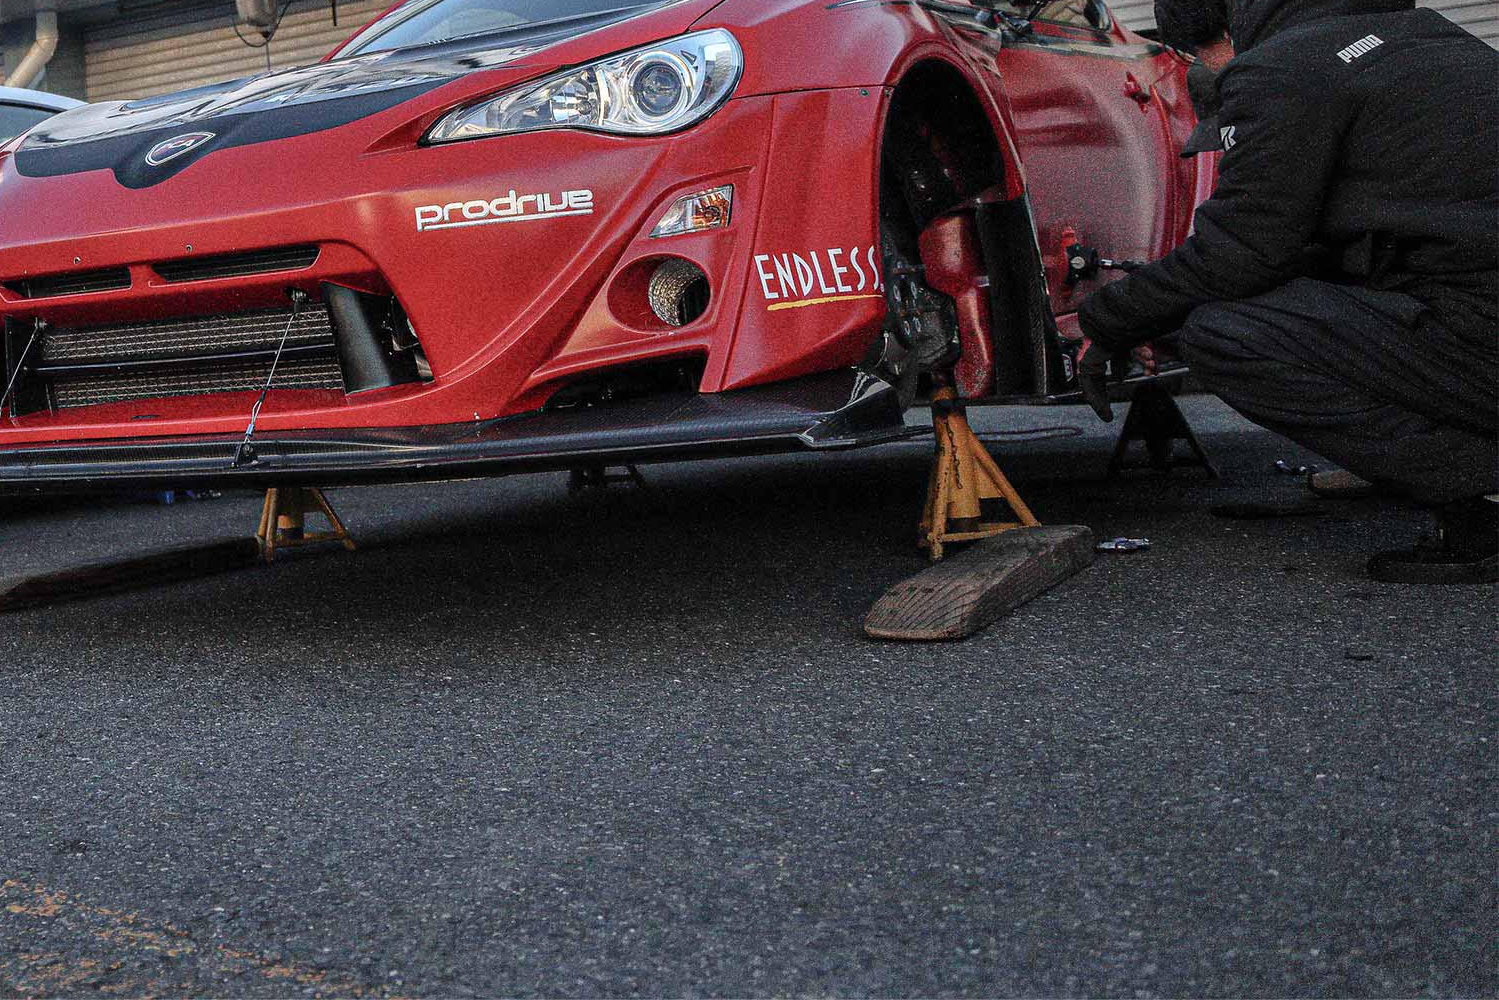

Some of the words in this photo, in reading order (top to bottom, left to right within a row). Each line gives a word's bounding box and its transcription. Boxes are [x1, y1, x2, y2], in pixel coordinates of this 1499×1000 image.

[1336, 34, 1384, 63] PUMA
[414, 189, 594, 232] prodrive
[754, 245, 880, 299] ENDLESS
